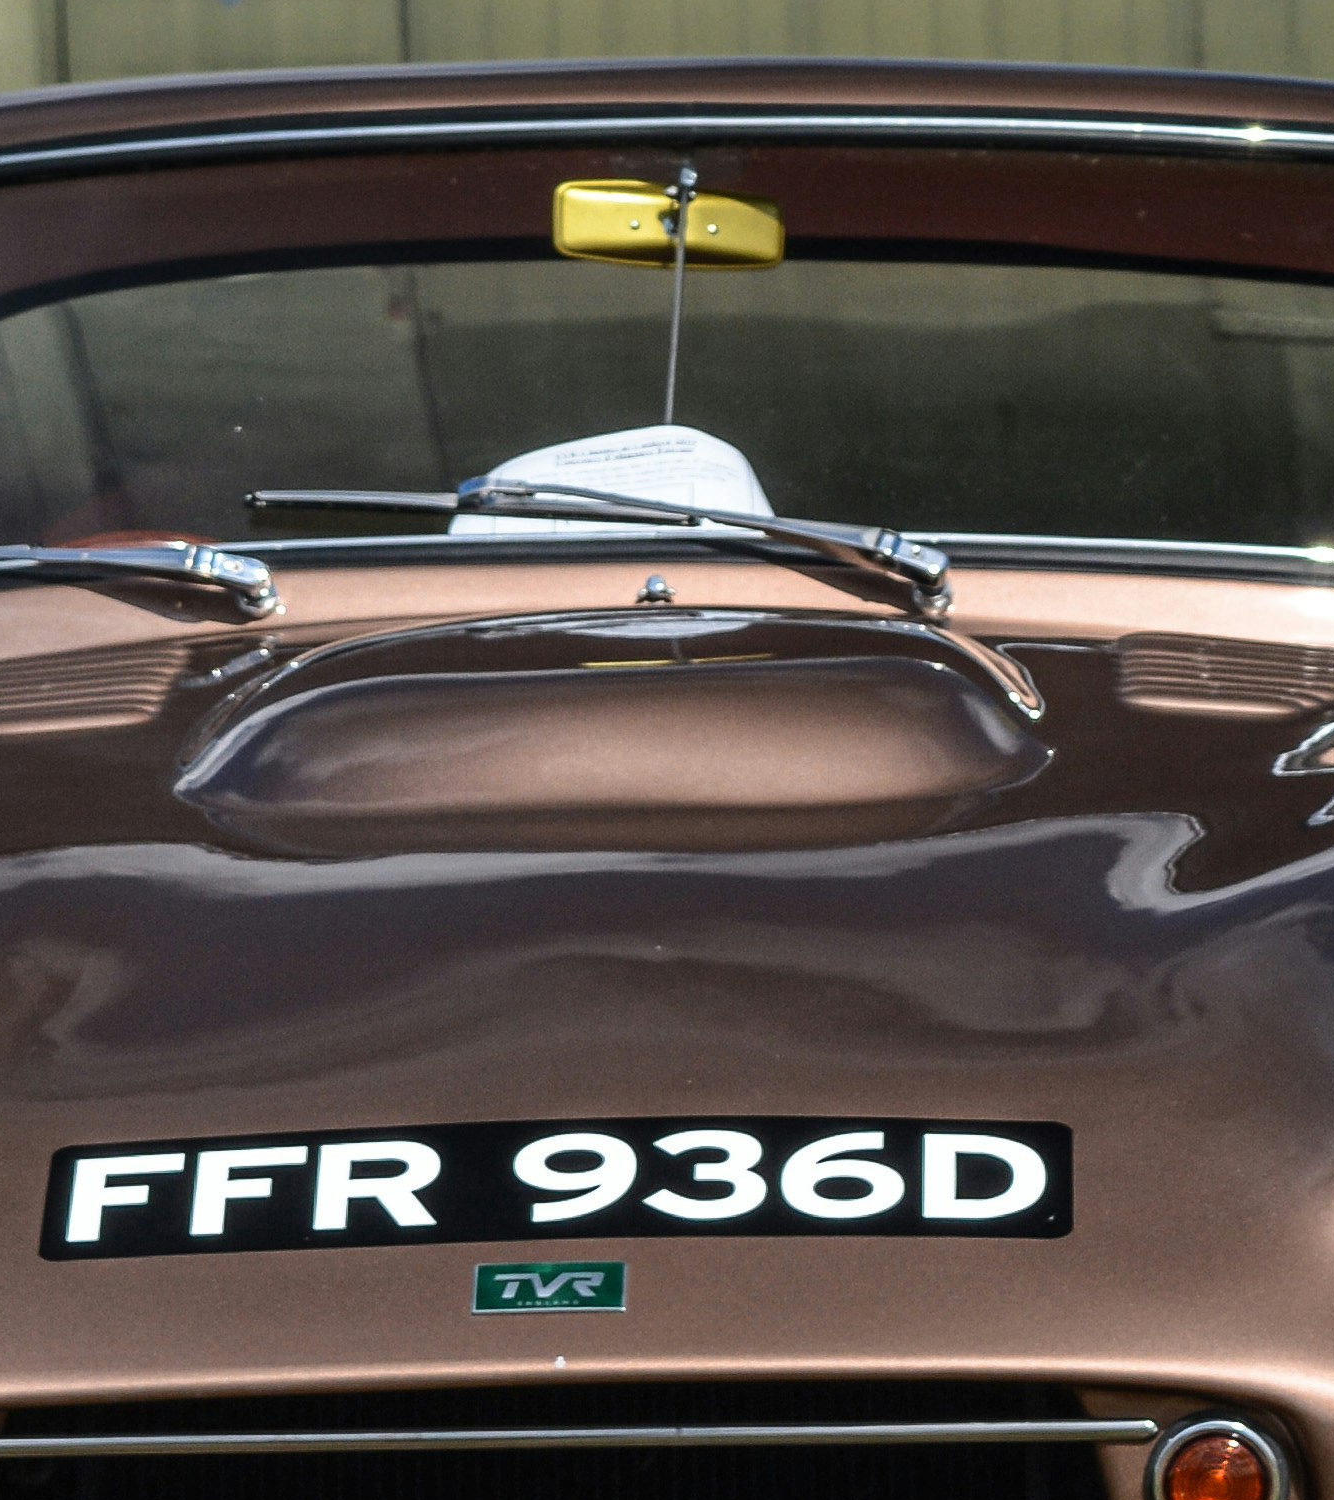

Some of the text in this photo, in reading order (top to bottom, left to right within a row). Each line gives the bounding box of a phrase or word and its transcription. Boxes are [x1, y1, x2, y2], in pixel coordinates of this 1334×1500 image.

[64, 1129, 1048, 1244] FFR 936D
[493, 1271, 606, 1299] TVR
